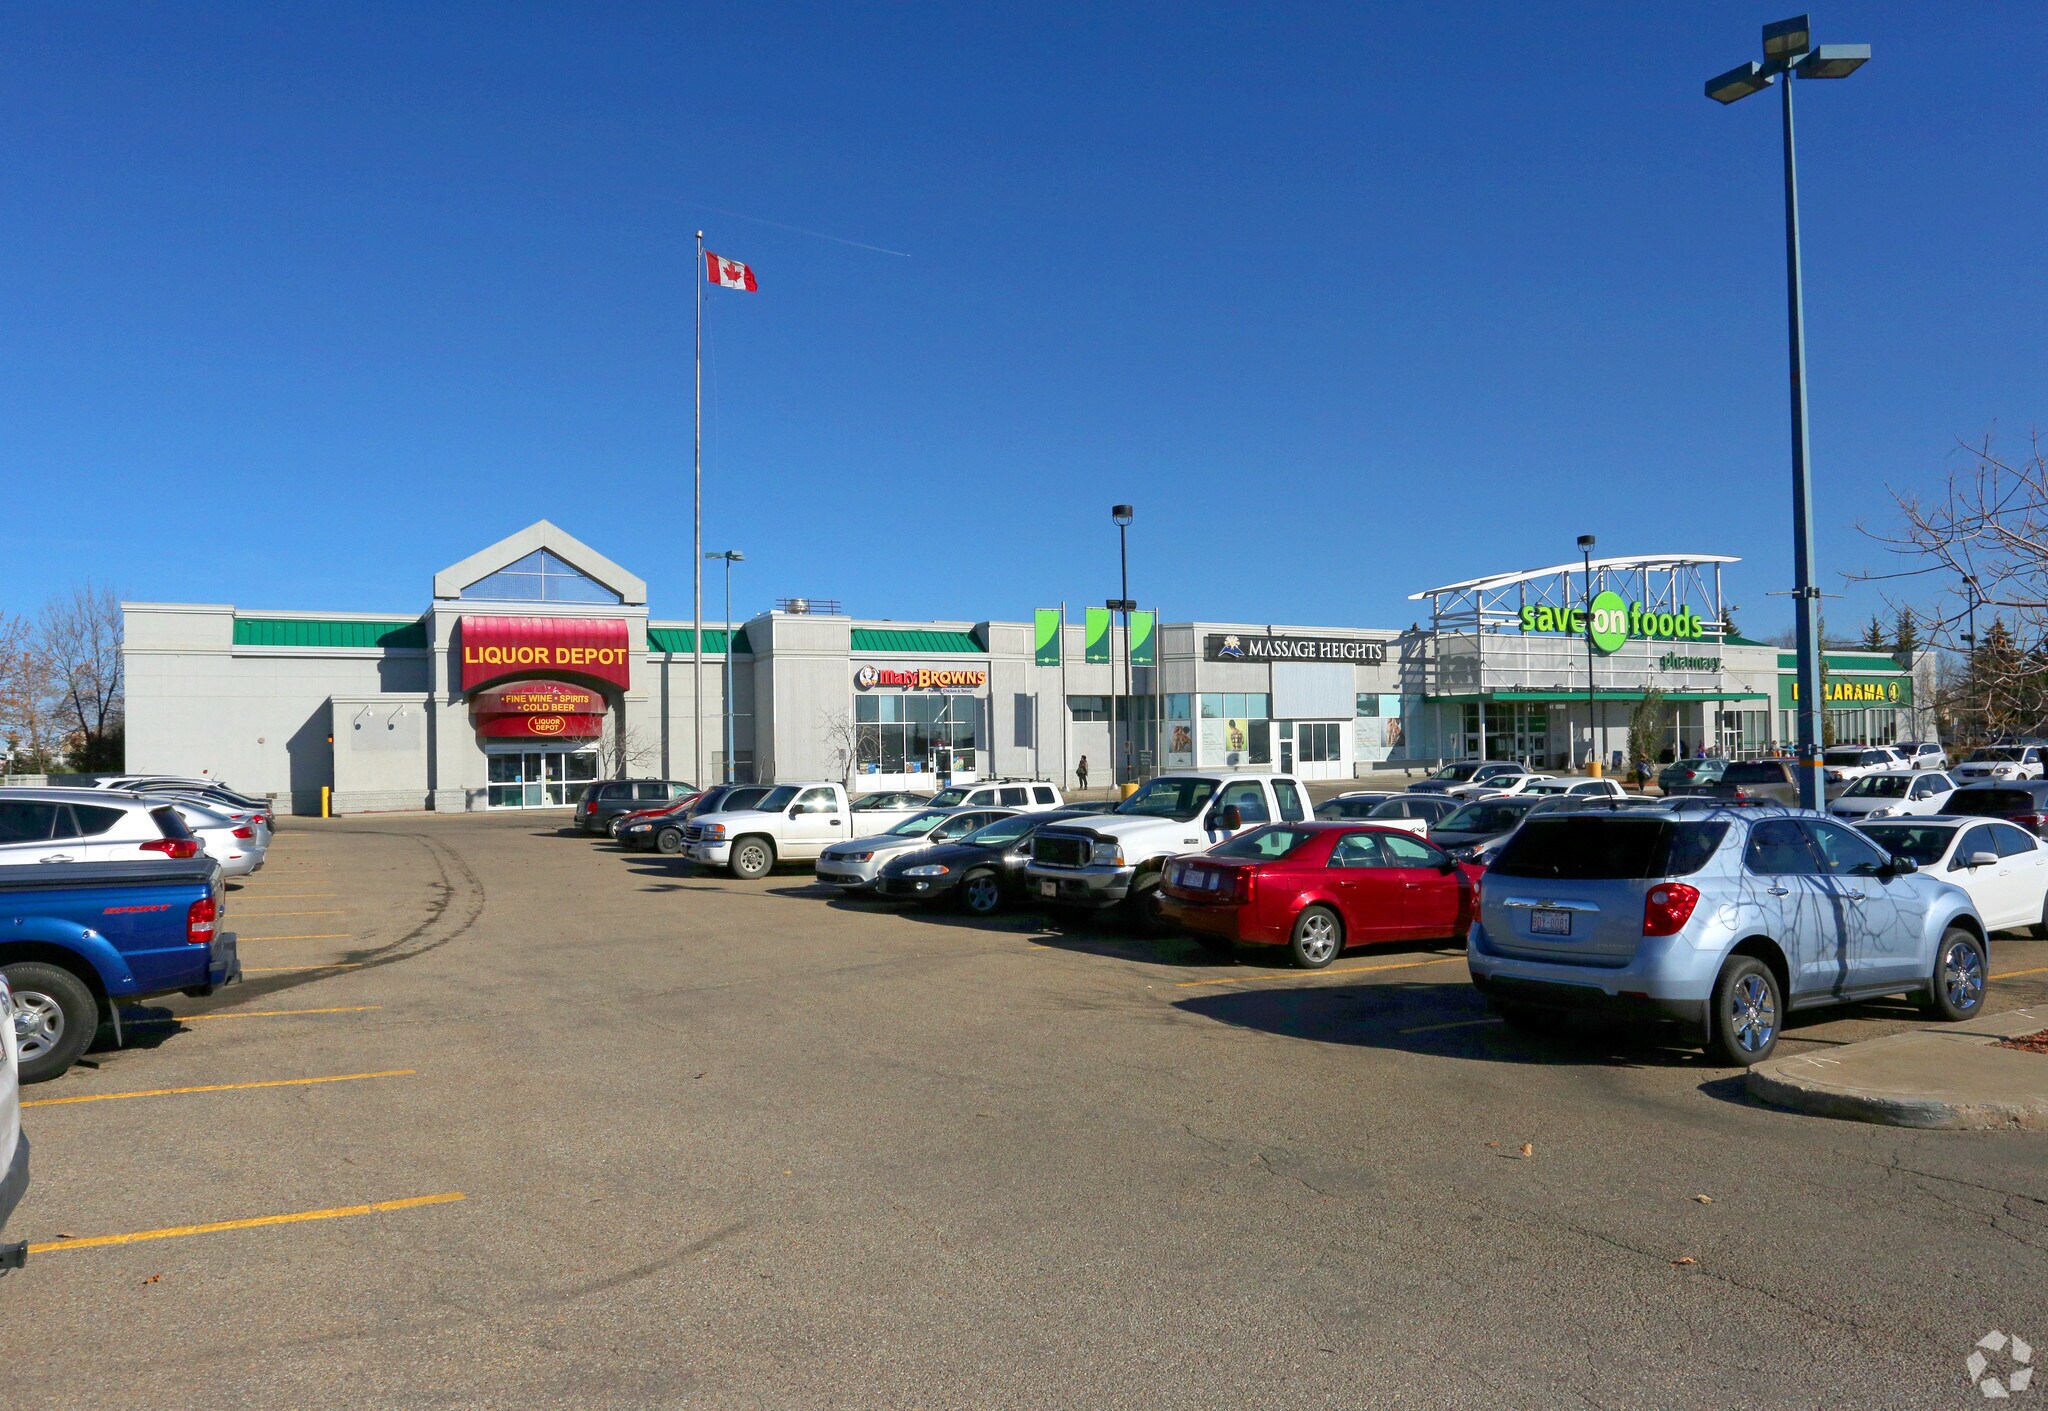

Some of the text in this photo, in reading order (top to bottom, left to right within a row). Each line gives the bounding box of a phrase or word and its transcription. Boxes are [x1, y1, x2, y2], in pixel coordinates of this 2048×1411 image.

[1520, 602, 1703, 638] save on foods
[465, 647, 626, 664] LIQUOR DEPOT
[1248, 640, 1382, 659] MASSAGE HEIGHTS
[506, 694, 589, 703] FINE WINE SPIRITS
[523, 703, 550, 711] COLD
[102, 904, 172, 914] SPORT
